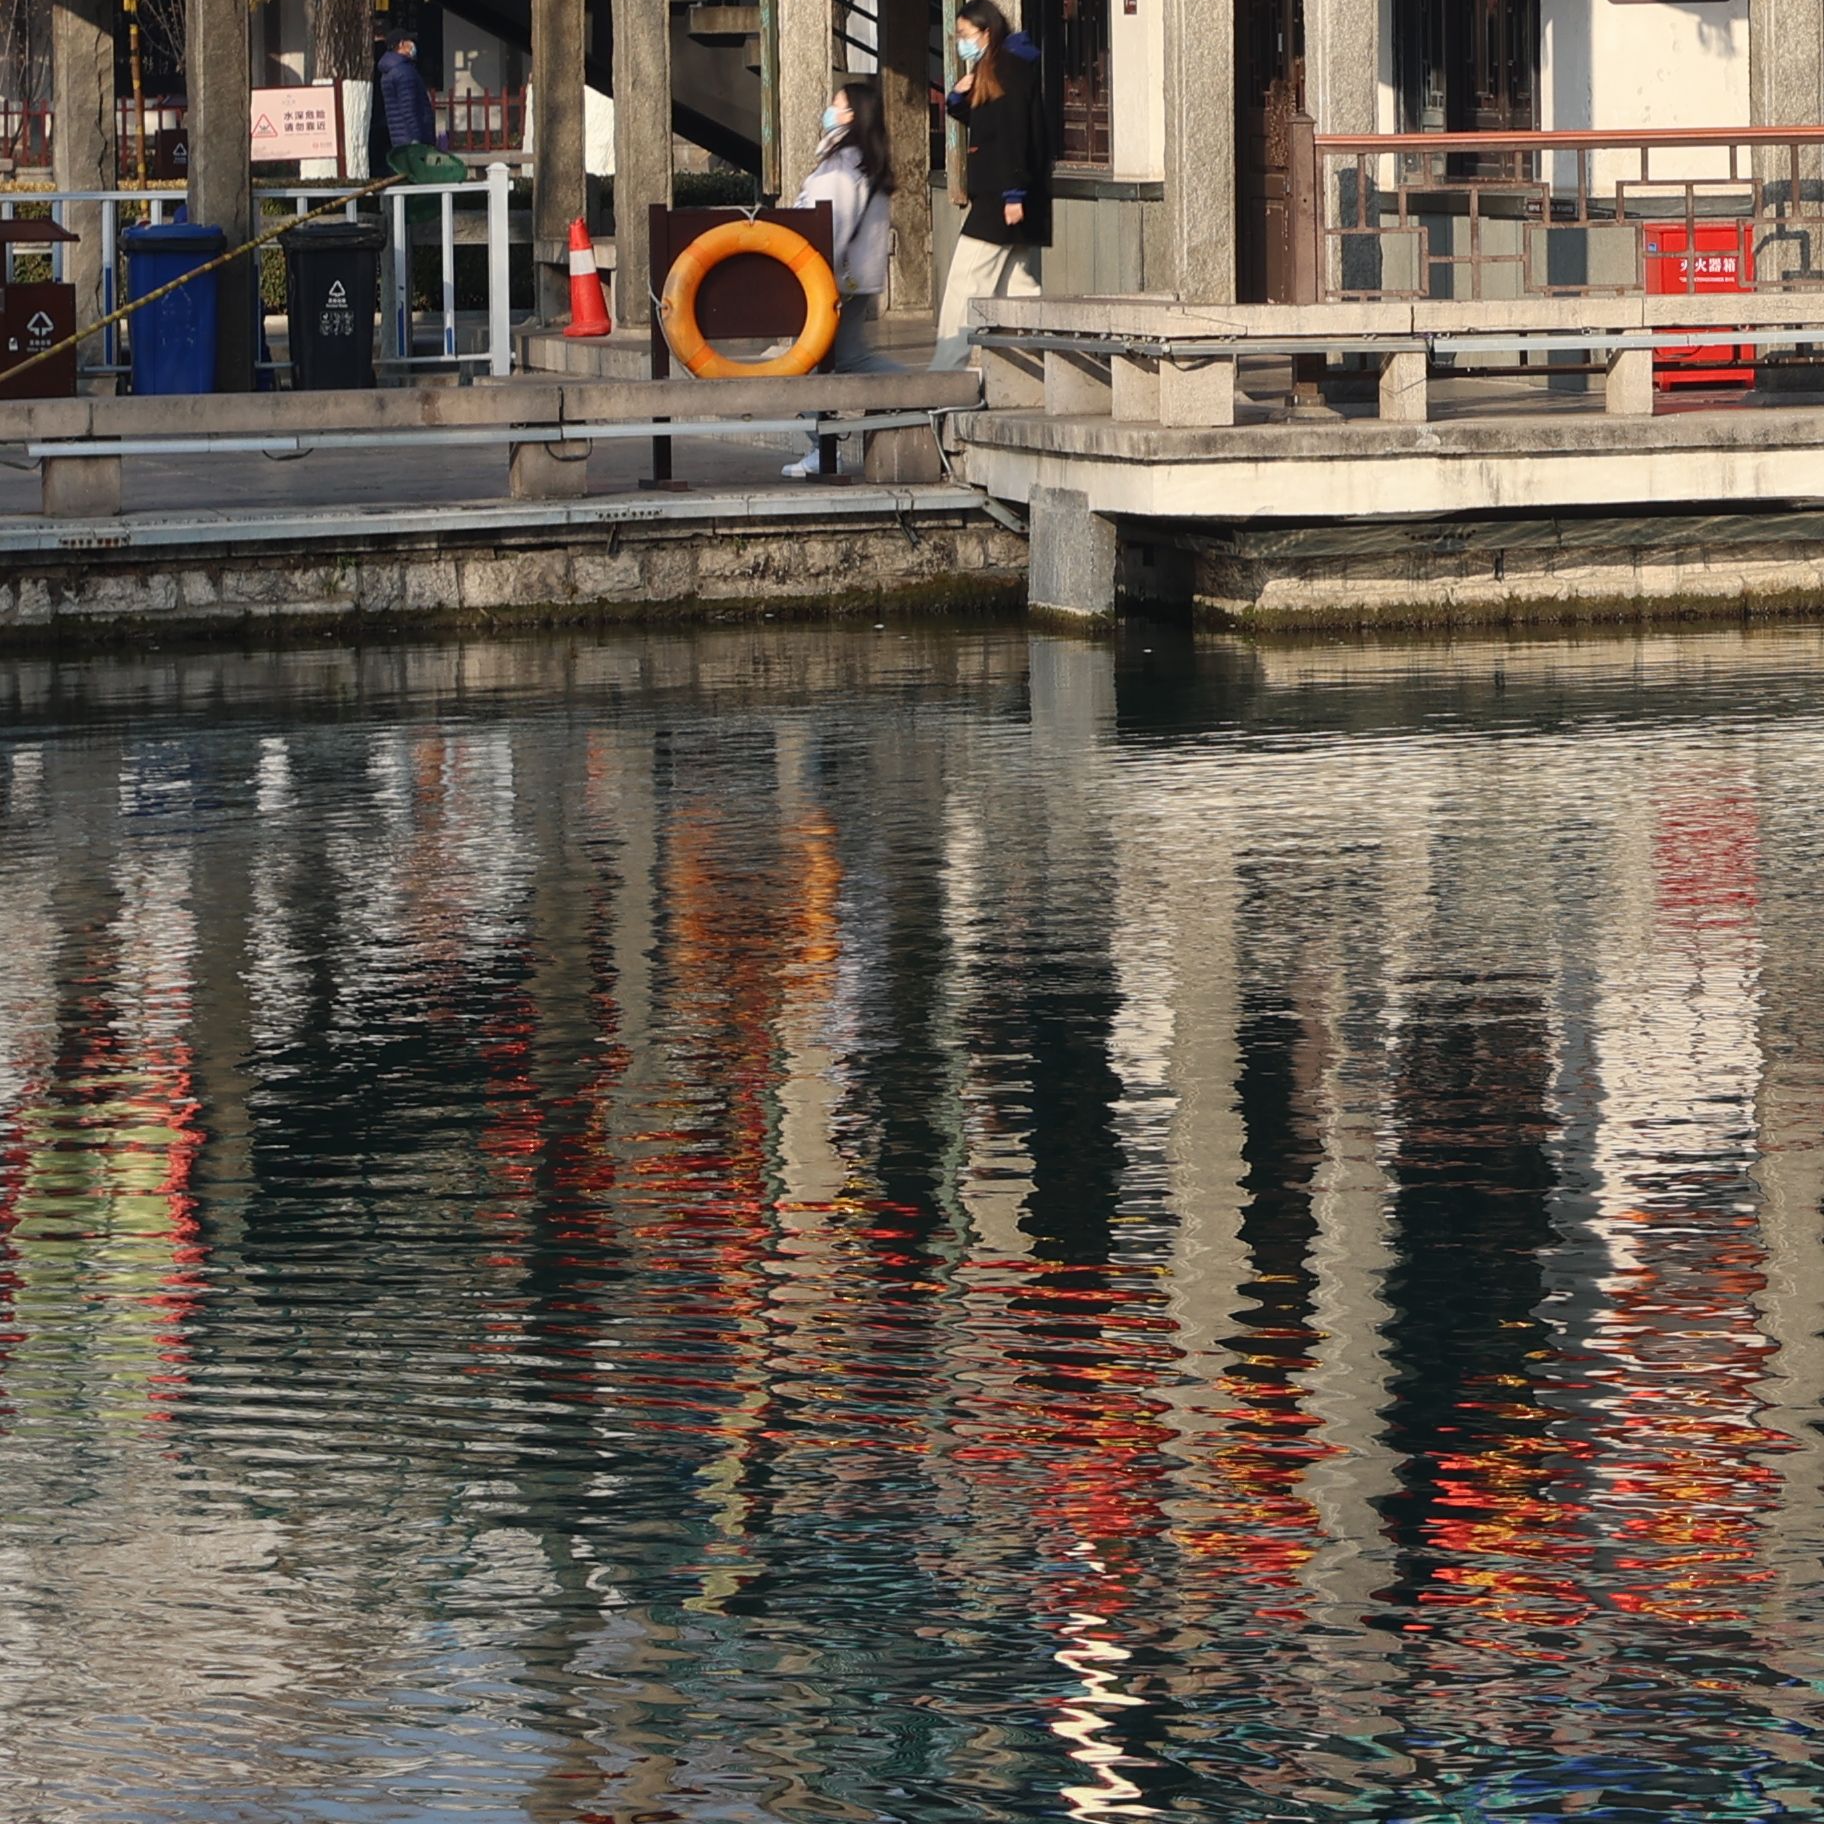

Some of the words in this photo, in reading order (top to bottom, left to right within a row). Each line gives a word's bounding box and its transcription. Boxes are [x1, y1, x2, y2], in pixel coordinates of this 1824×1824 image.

[283, 110, 326, 121] 水深危险
[284, 121, 326, 132] 请勿靠近
